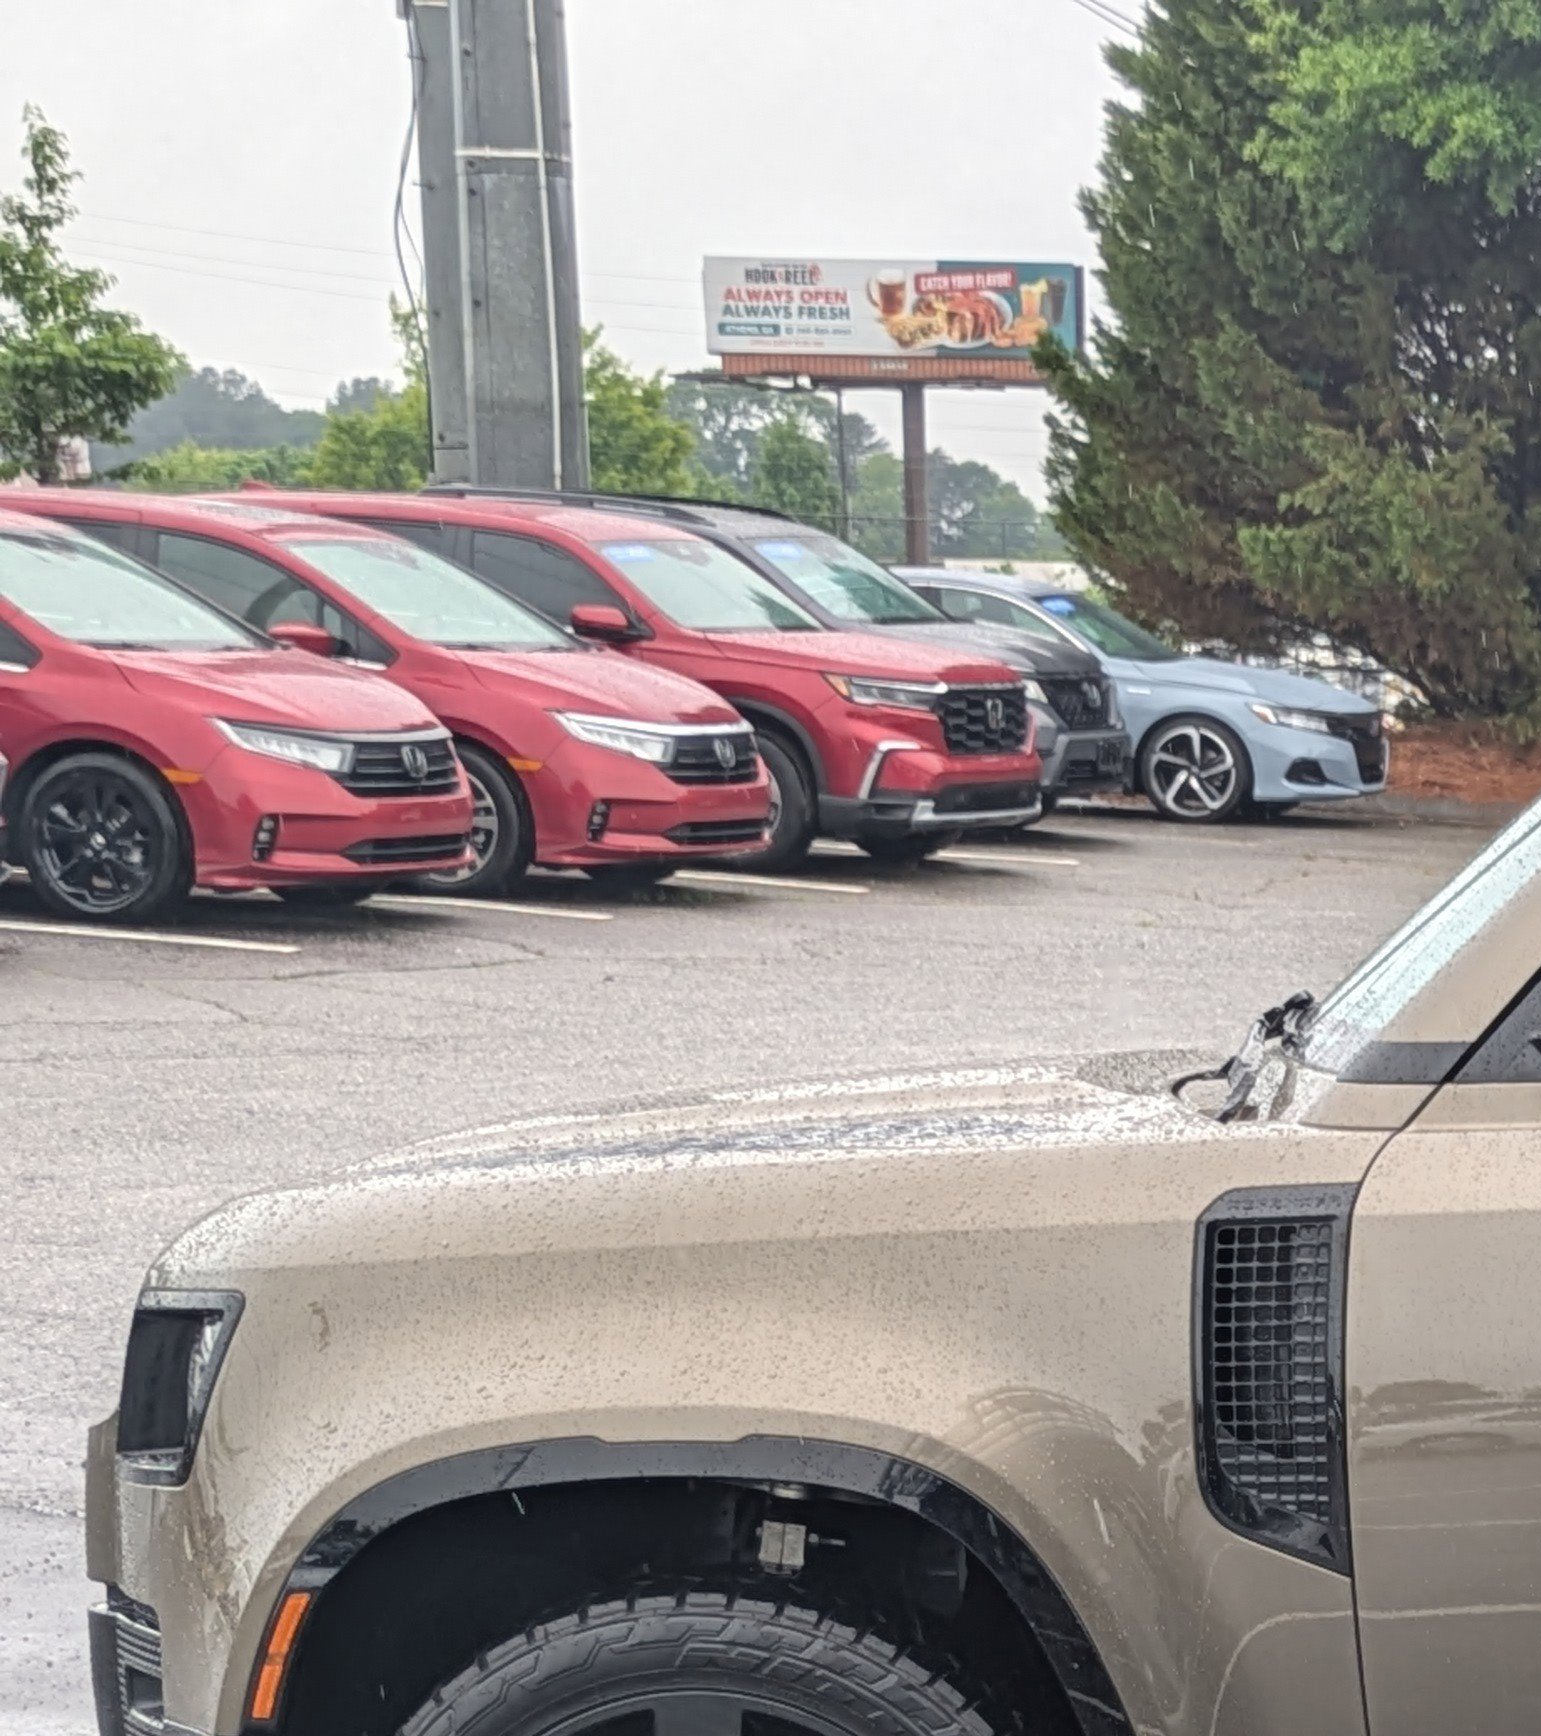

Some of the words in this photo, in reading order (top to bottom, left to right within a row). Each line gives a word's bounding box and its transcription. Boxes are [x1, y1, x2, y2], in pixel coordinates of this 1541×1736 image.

[723, 287, 793, 304] ALWAYS
[800, 290, 848, 305] OPEN
[722, 303, 793, 319] ALWAYS
[798, 305, 851, 320] FRESH
